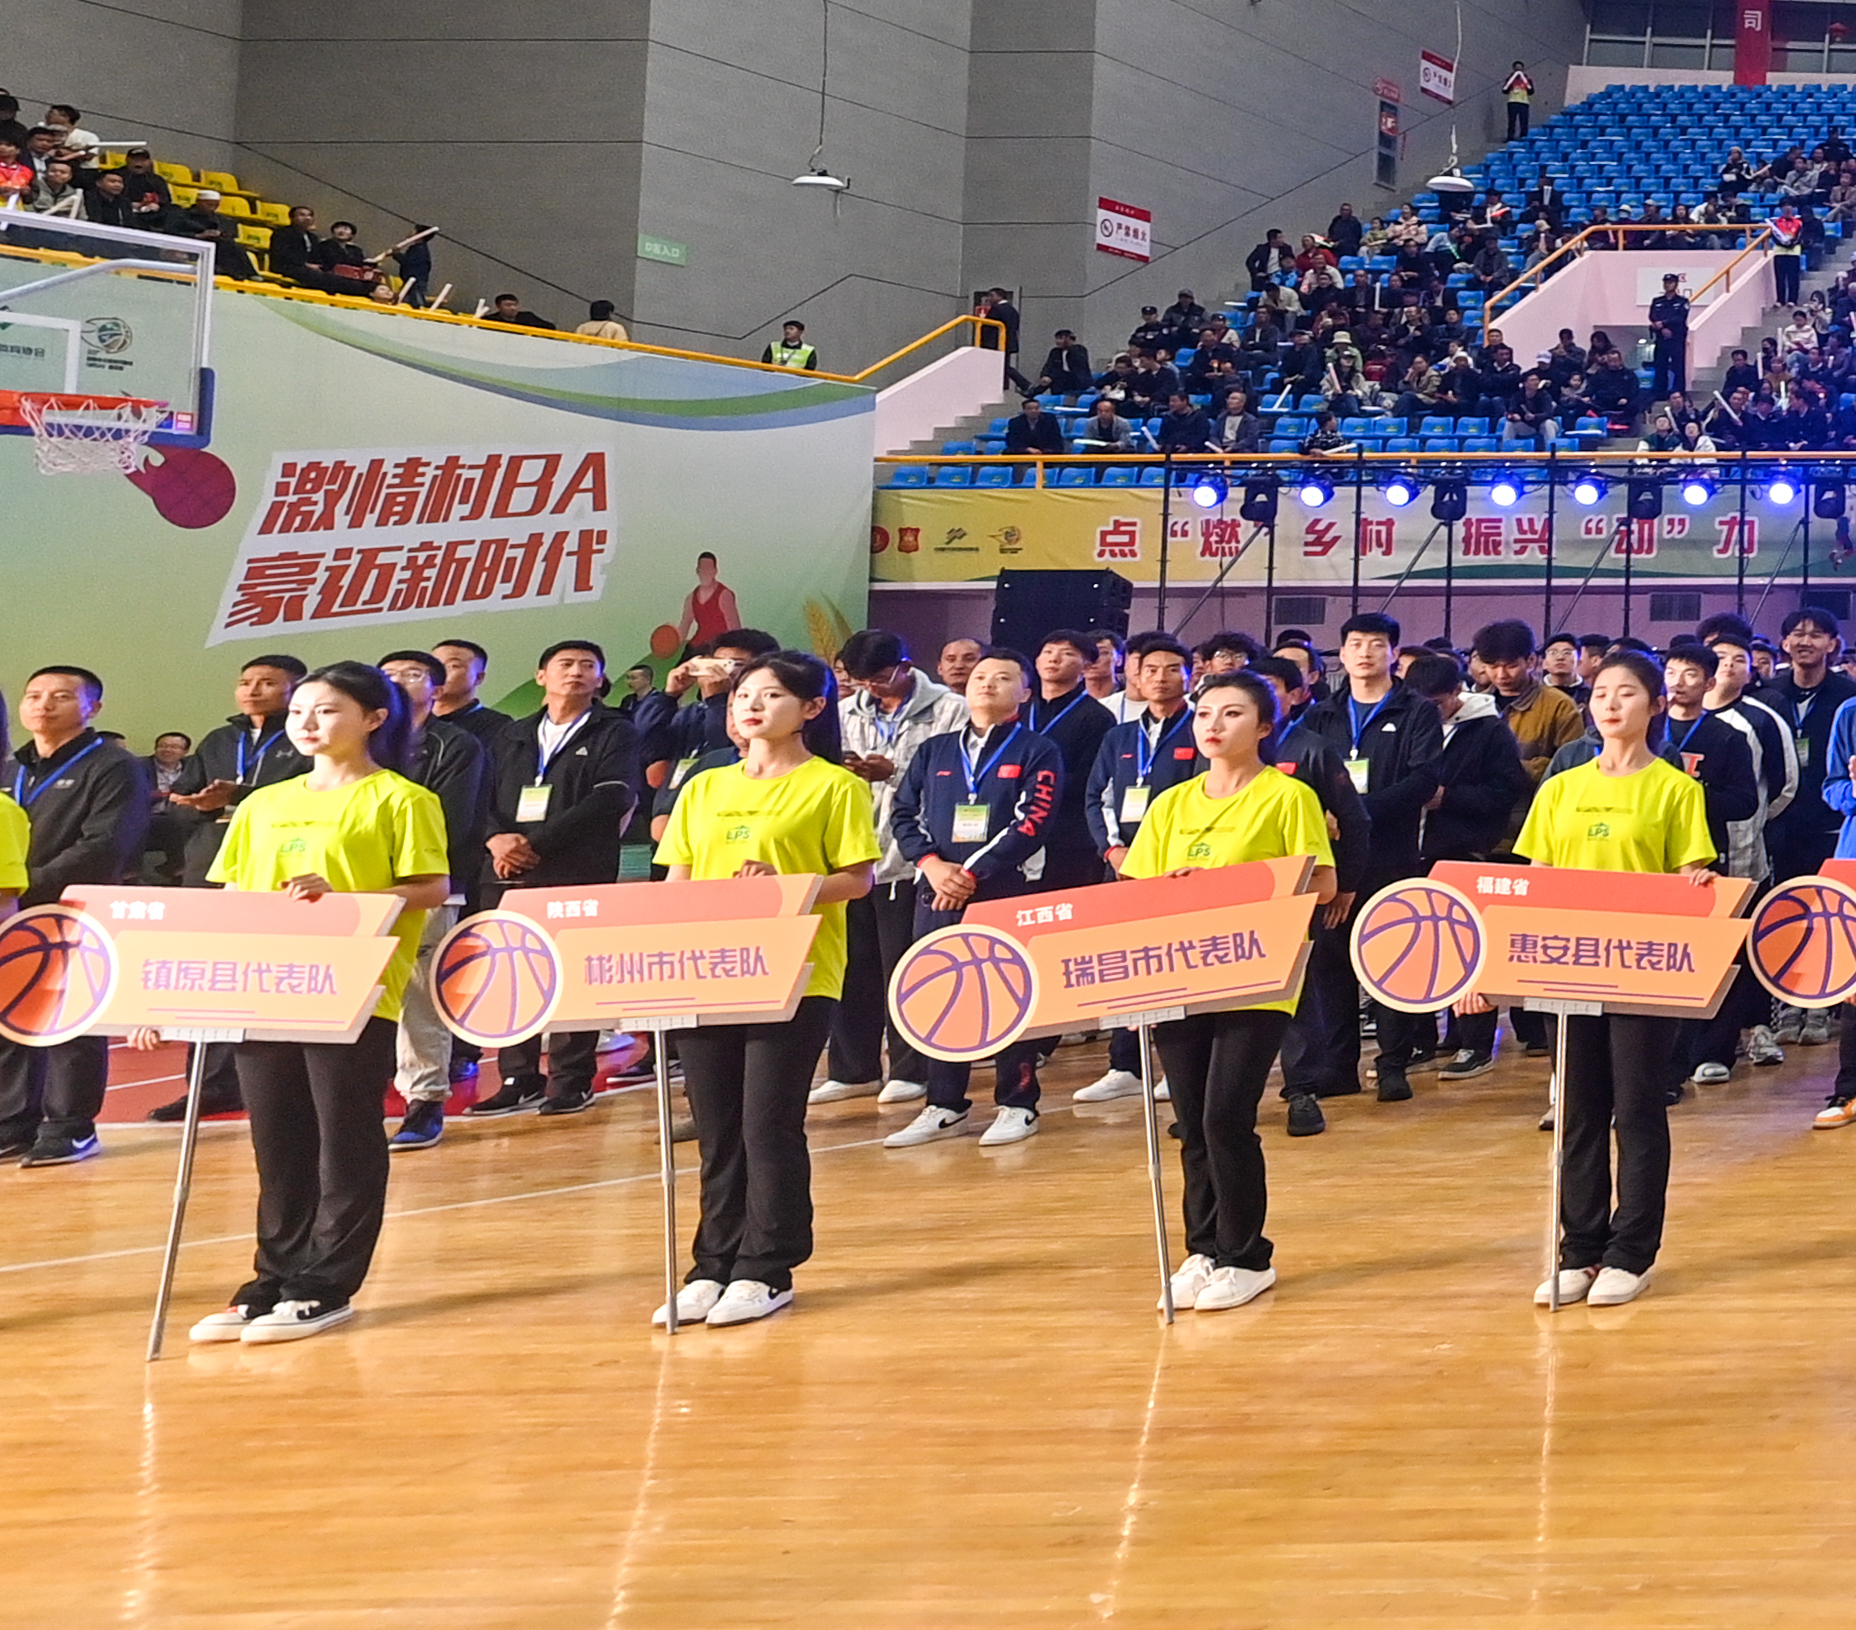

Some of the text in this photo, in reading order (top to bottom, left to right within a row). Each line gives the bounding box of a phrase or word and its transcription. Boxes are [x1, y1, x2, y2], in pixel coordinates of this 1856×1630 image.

[256, 450, 609, 537] 激情村BA
[224, 528, 608, 630] 豪迈新时代
[1017, 769, 1057, 837] CHINA
[726, 827, 751, 843] LPS
[1587, 825, 1610, 840] LPS
[1186, 843, 1212, 859] LPS
[1475, 874, 1530, 898] 福建省
[109, 899, 166, 921] 甘肃省
[546, 898, 600, 920] 陕西省
[1015, 902, 1074, 928] 江西省
[583, 947, 771, 987] 彬州市代表队
[1060, 929, 1268, 988] 瑞昌市代表队
[1506, 931, 1696, 974] 惠安县代表队
[140, 957, 339, 996] 镇原县代表队
